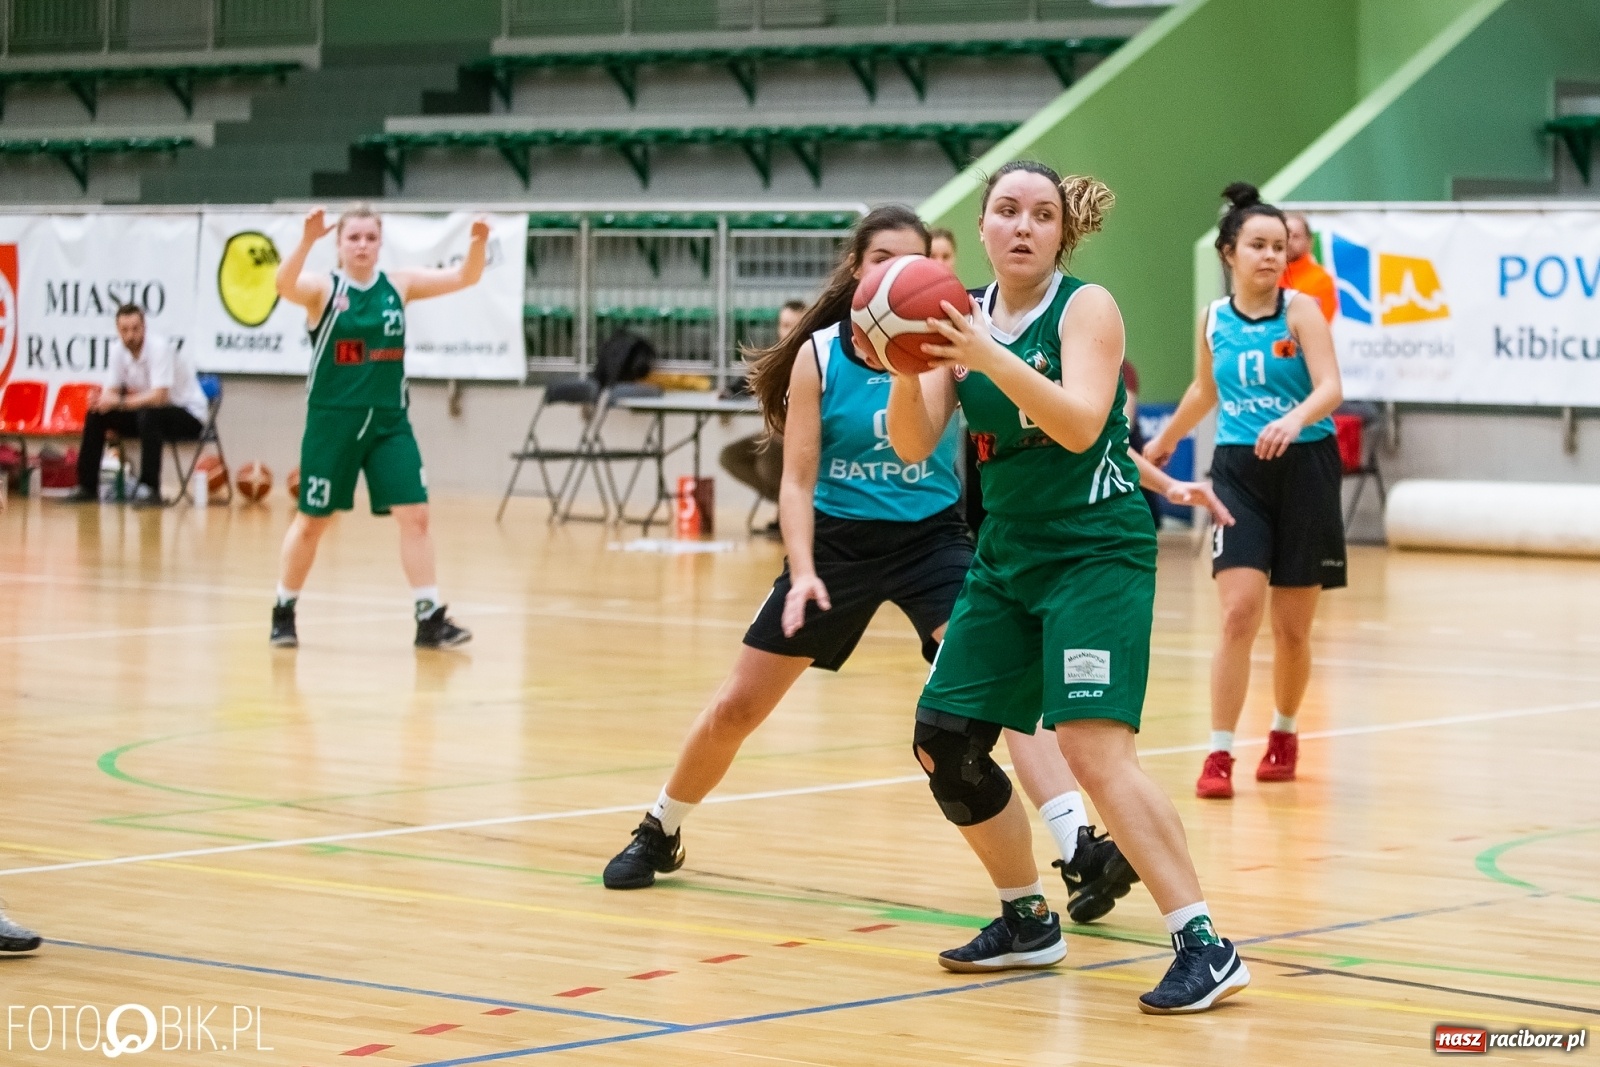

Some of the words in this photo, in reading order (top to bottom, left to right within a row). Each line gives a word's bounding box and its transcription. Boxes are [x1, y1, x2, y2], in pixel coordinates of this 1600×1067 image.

[46, 280, 165, 317] MIASTO
[1238, 349, 1266, 388] 13
[829, 457, 935, 484] BATPOL
[306, 475, 331, 508] 23
[1068, 690, 1103, 699] COLO
